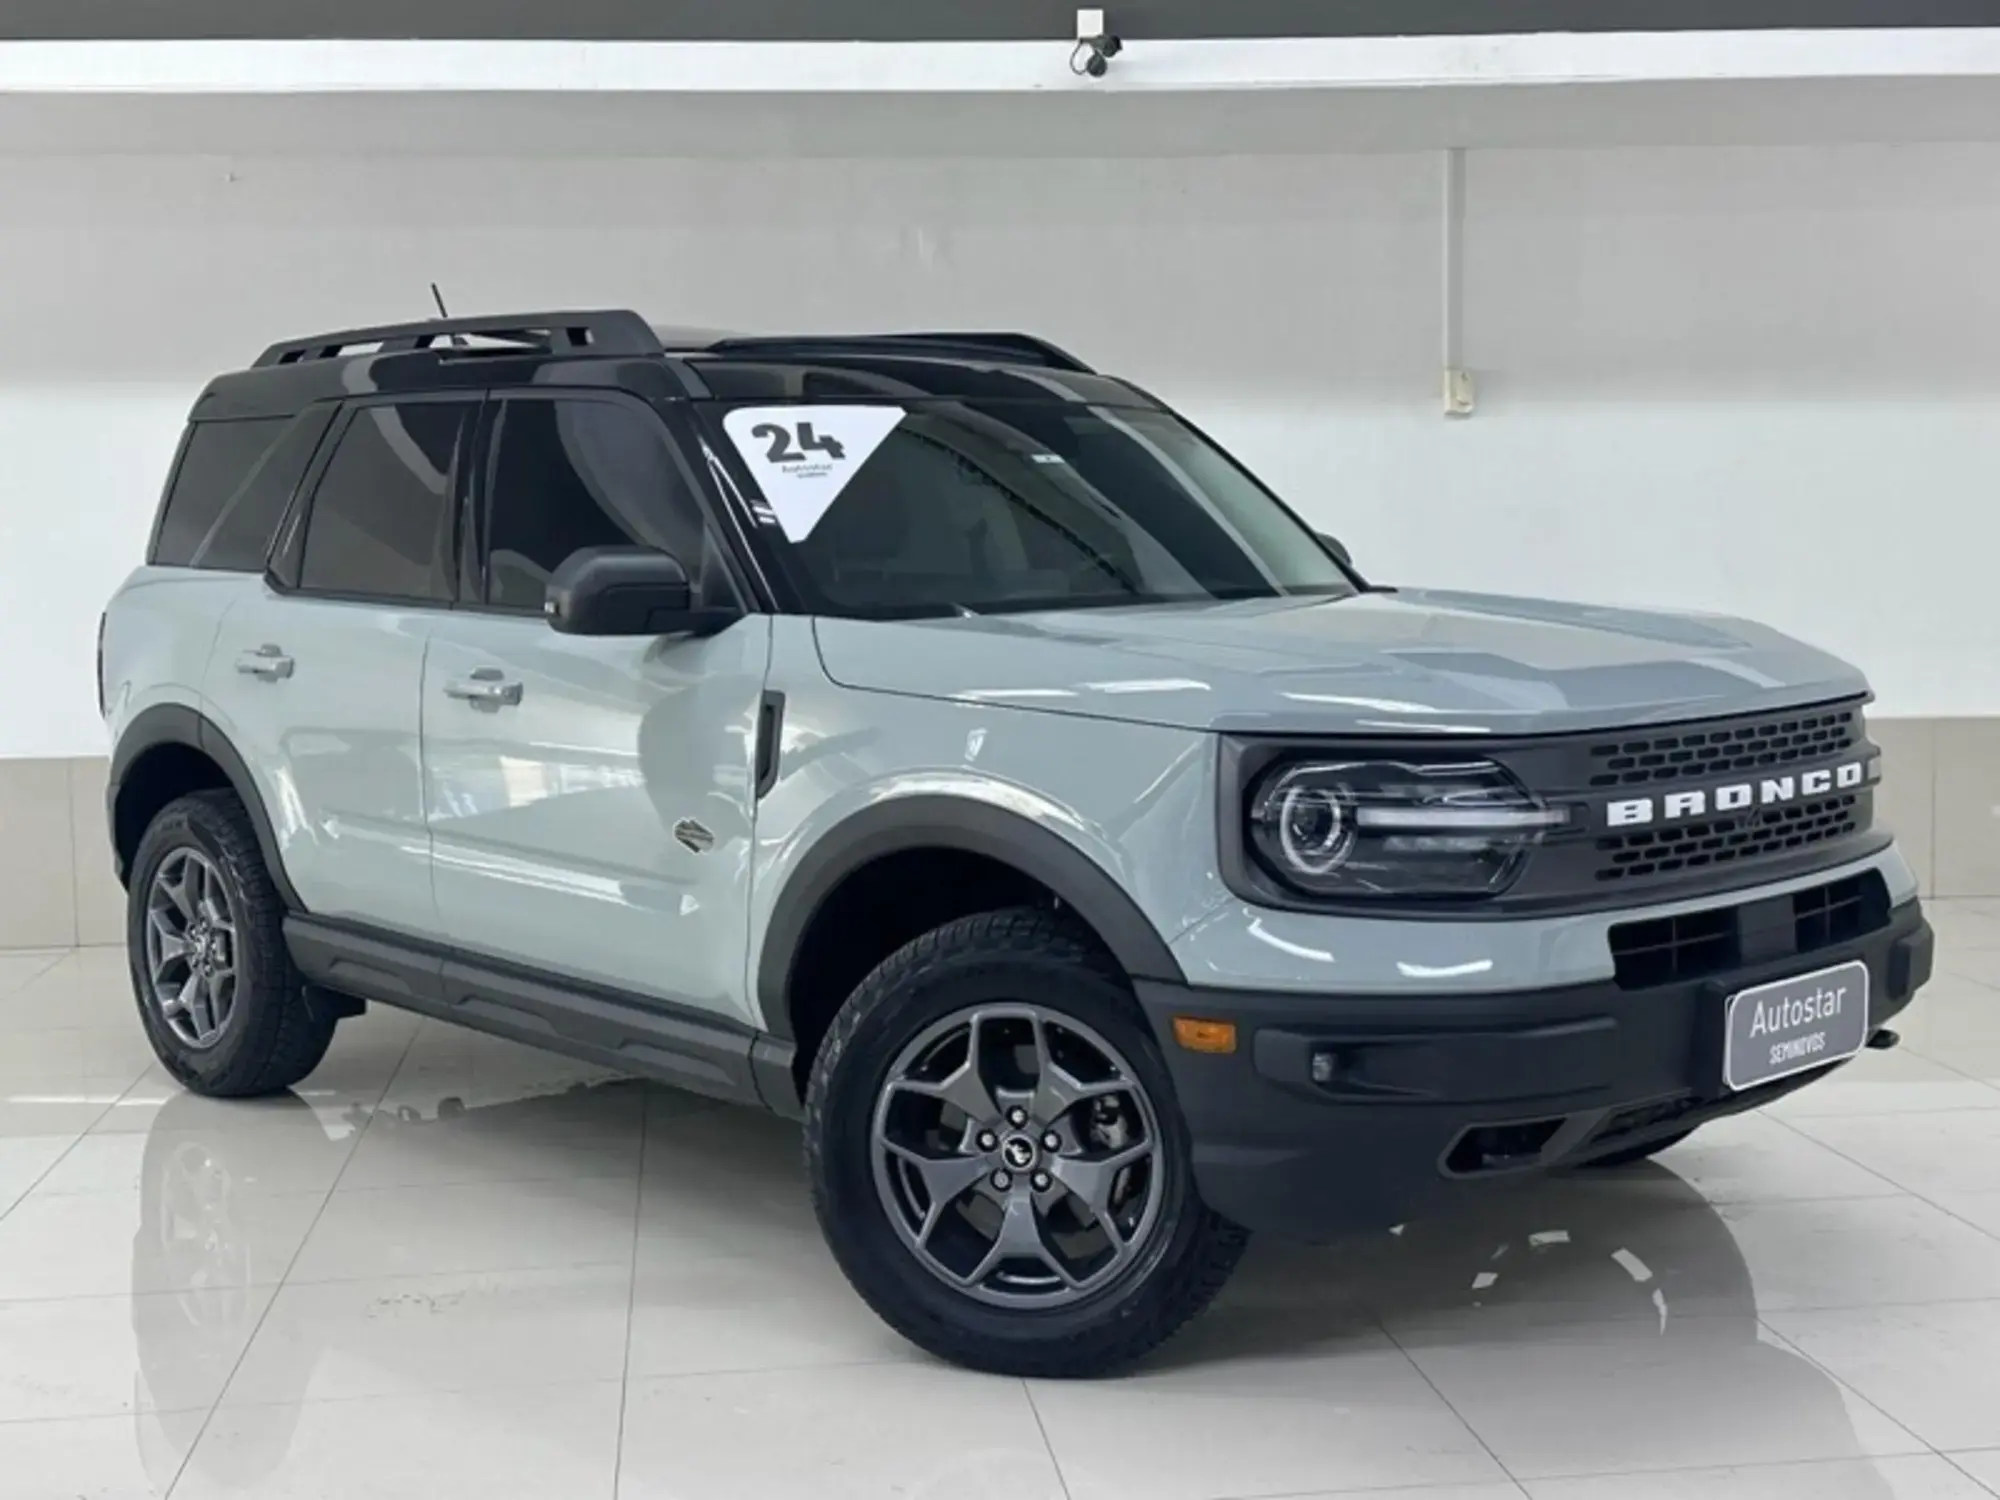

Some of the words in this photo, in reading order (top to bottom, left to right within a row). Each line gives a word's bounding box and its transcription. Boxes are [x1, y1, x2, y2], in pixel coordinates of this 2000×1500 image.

[752, 422, 845, 463] 24
[1606, 762, 1862, 827] BRONCO
[1750, 987, 1847, 1038] Autostar
